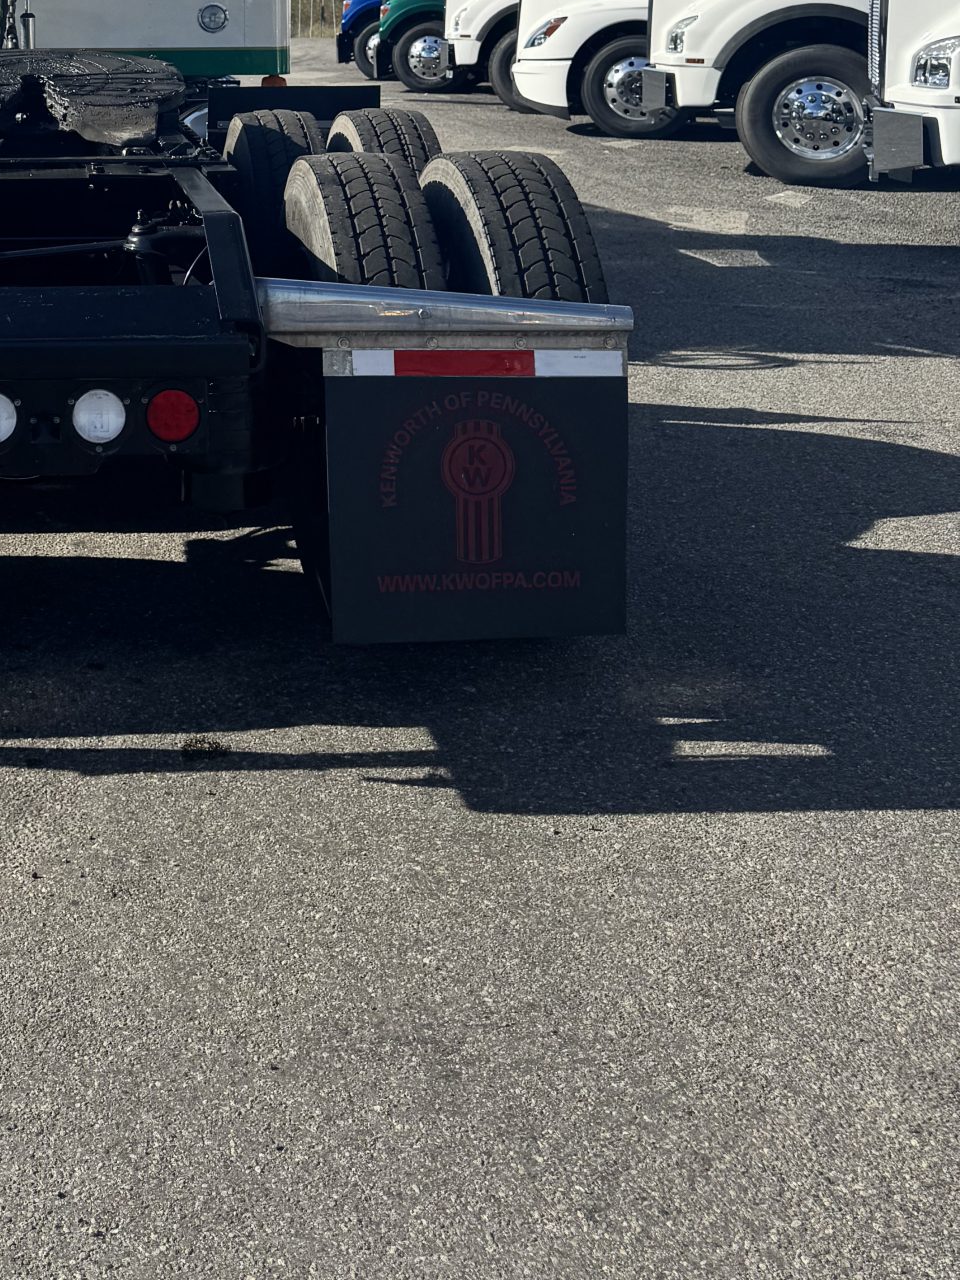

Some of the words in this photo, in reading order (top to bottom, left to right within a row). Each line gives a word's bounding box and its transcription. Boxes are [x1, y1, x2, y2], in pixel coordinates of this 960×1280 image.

[380, 400, 442, 508] KENWORTH
[444, 391, 473, 411] OF
[477, 390, 577, 506] PENNSYLVANIA
[468, 444, 486, 466] K
[463, 467, 492, 488] W
[377, 571, 581, 593] WWW.KWOFPA.COM
